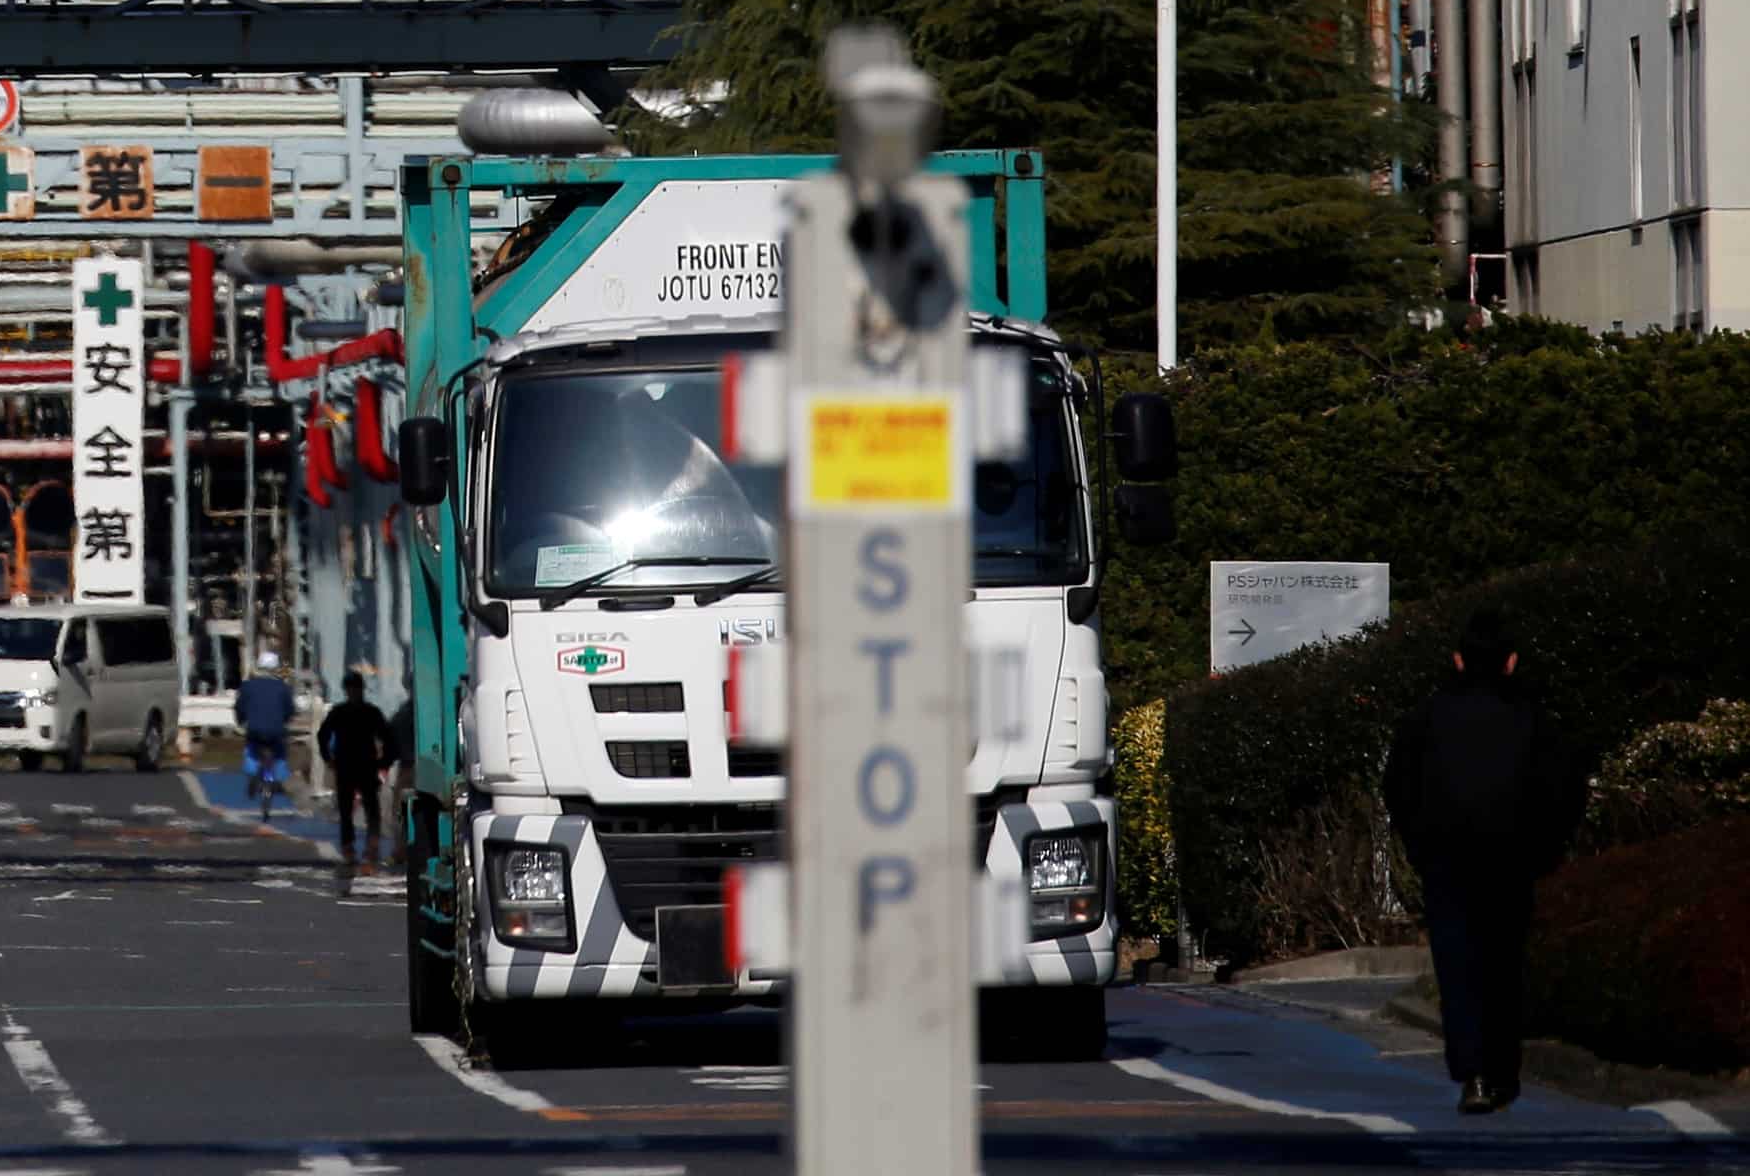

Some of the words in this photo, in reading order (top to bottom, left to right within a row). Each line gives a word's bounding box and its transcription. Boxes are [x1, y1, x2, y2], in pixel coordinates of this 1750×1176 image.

[677, 244, 750, 271] FRONT
[657, 275, 712, 302] JOTU
[555, 631, 630, 644] GIGA
[855, 526, 919, 940] STOP
